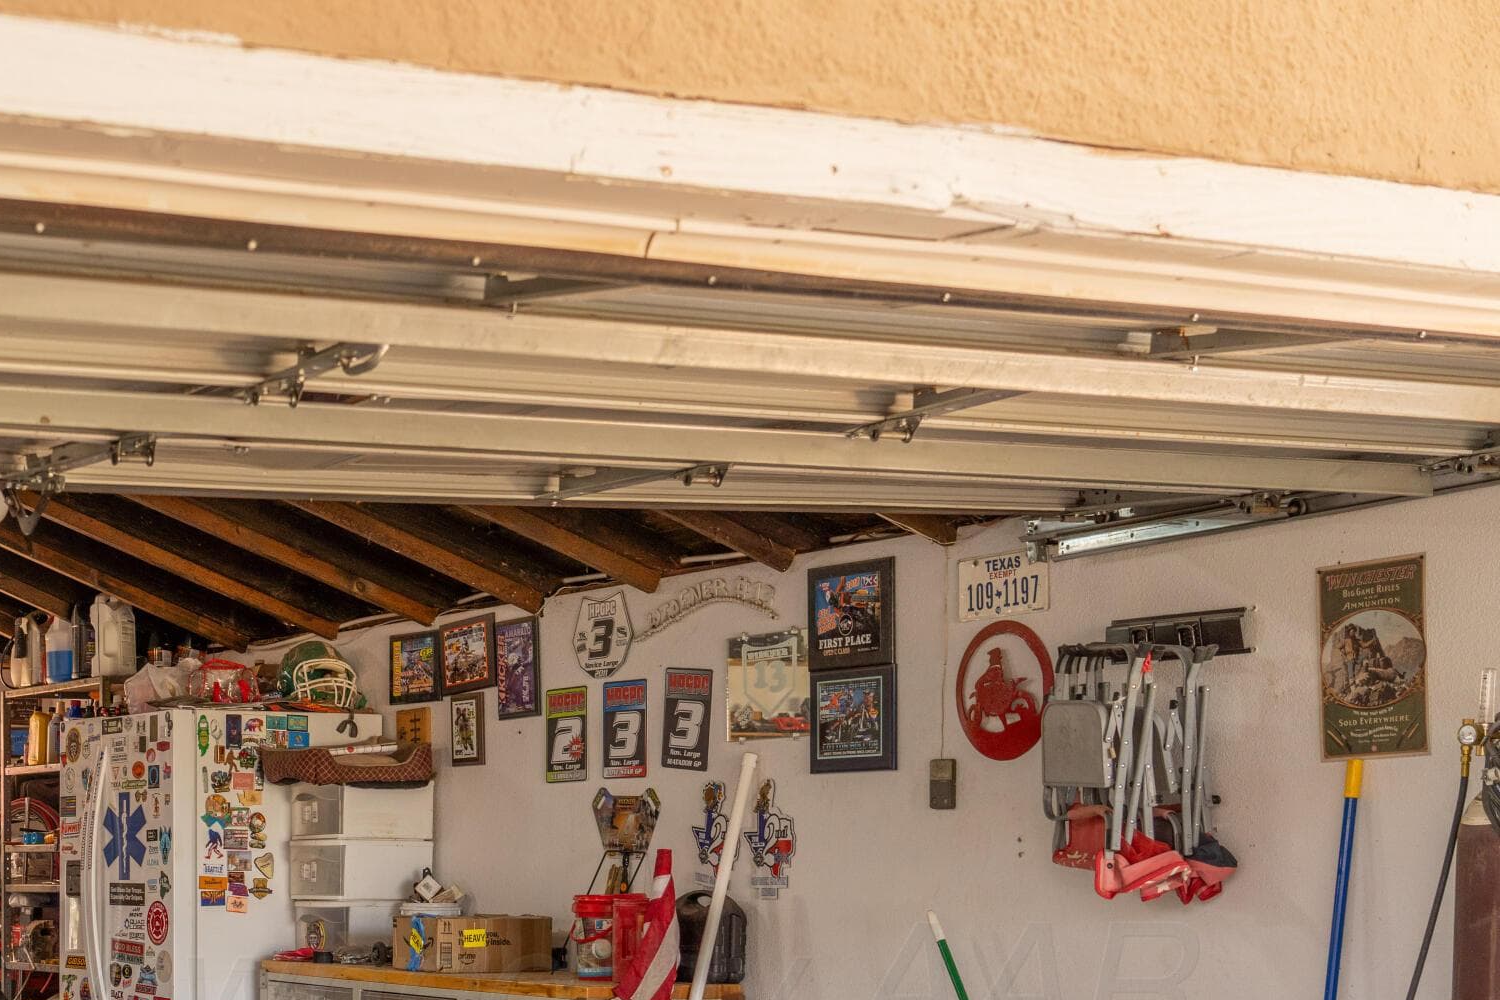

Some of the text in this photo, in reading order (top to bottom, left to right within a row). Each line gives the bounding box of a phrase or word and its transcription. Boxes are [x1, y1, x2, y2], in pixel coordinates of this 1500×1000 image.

[985, 556, 1021, 572] TEXAS
[989, 569, 1017, 580] EXEMPT
[1326, 564, 1417, 592] WINCHESTER
[1341, 598, 1401, 611] AMMUNITION
[587, 617, 615, 661] 3
[818, 637, 843, 649] FIRST
[844, 633, 872, 646] PLACE
[753, 660, 787, 693] 13
[669, 700, 706, 750] 3
[1338, 714, 1411, 727] SOLD EVERYWHERE
[609, 710, 642, 759] 3
[464, 933, 486, 943] HEAVY
[457, 952, 477, 961] prime
